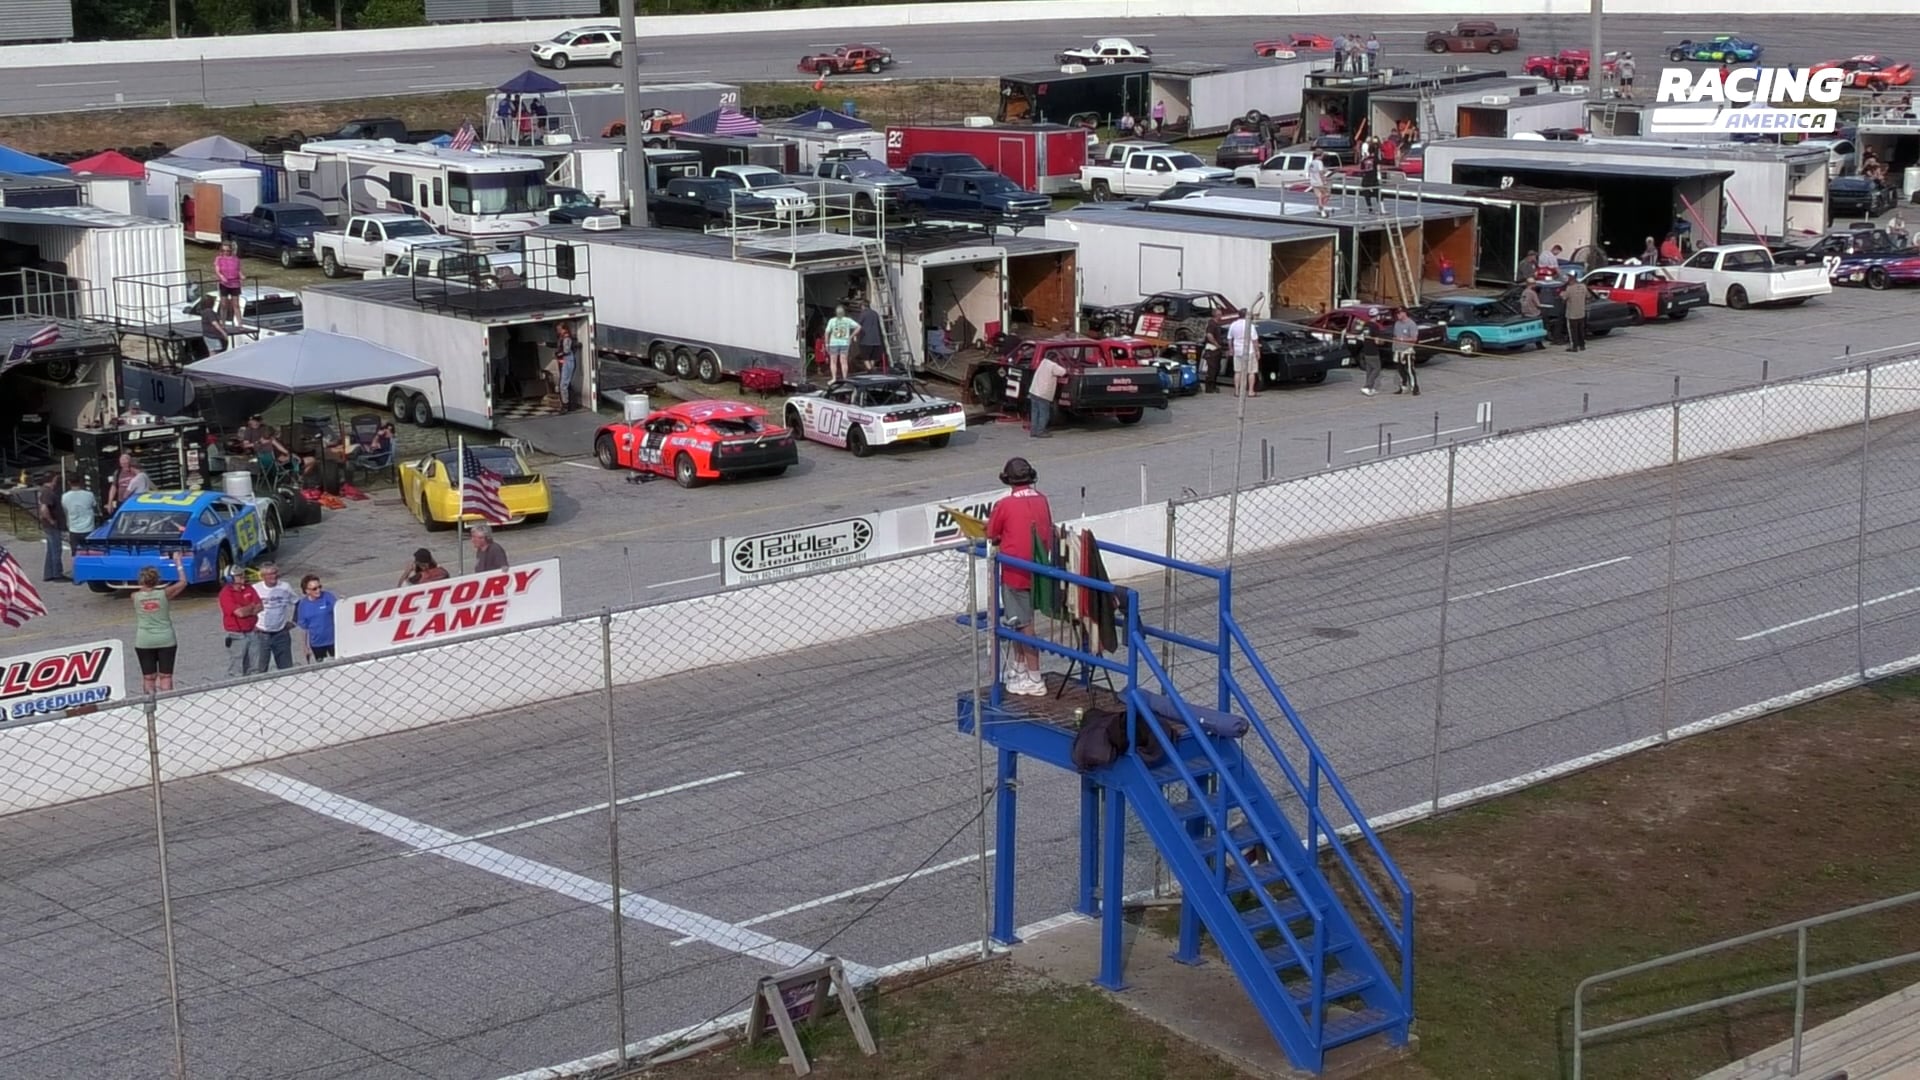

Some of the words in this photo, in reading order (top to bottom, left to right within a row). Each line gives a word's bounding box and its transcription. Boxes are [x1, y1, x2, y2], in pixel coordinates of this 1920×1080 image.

[719, 92, 737, 104] 20
[887, 130, 904, 149] 23
[1823, 255, 1842, 278] 52
[151, 378, 165, 404] 10
[818, 406, 844, 437] 01
[236, 511, 259, 552] 63
[760, 534, 847, 561] Peddler
[353, 568, 543, 625] VICTORY
[392, 600, 509, 645] LANE
[12, 686, 112, 720] SPEEDWAY
